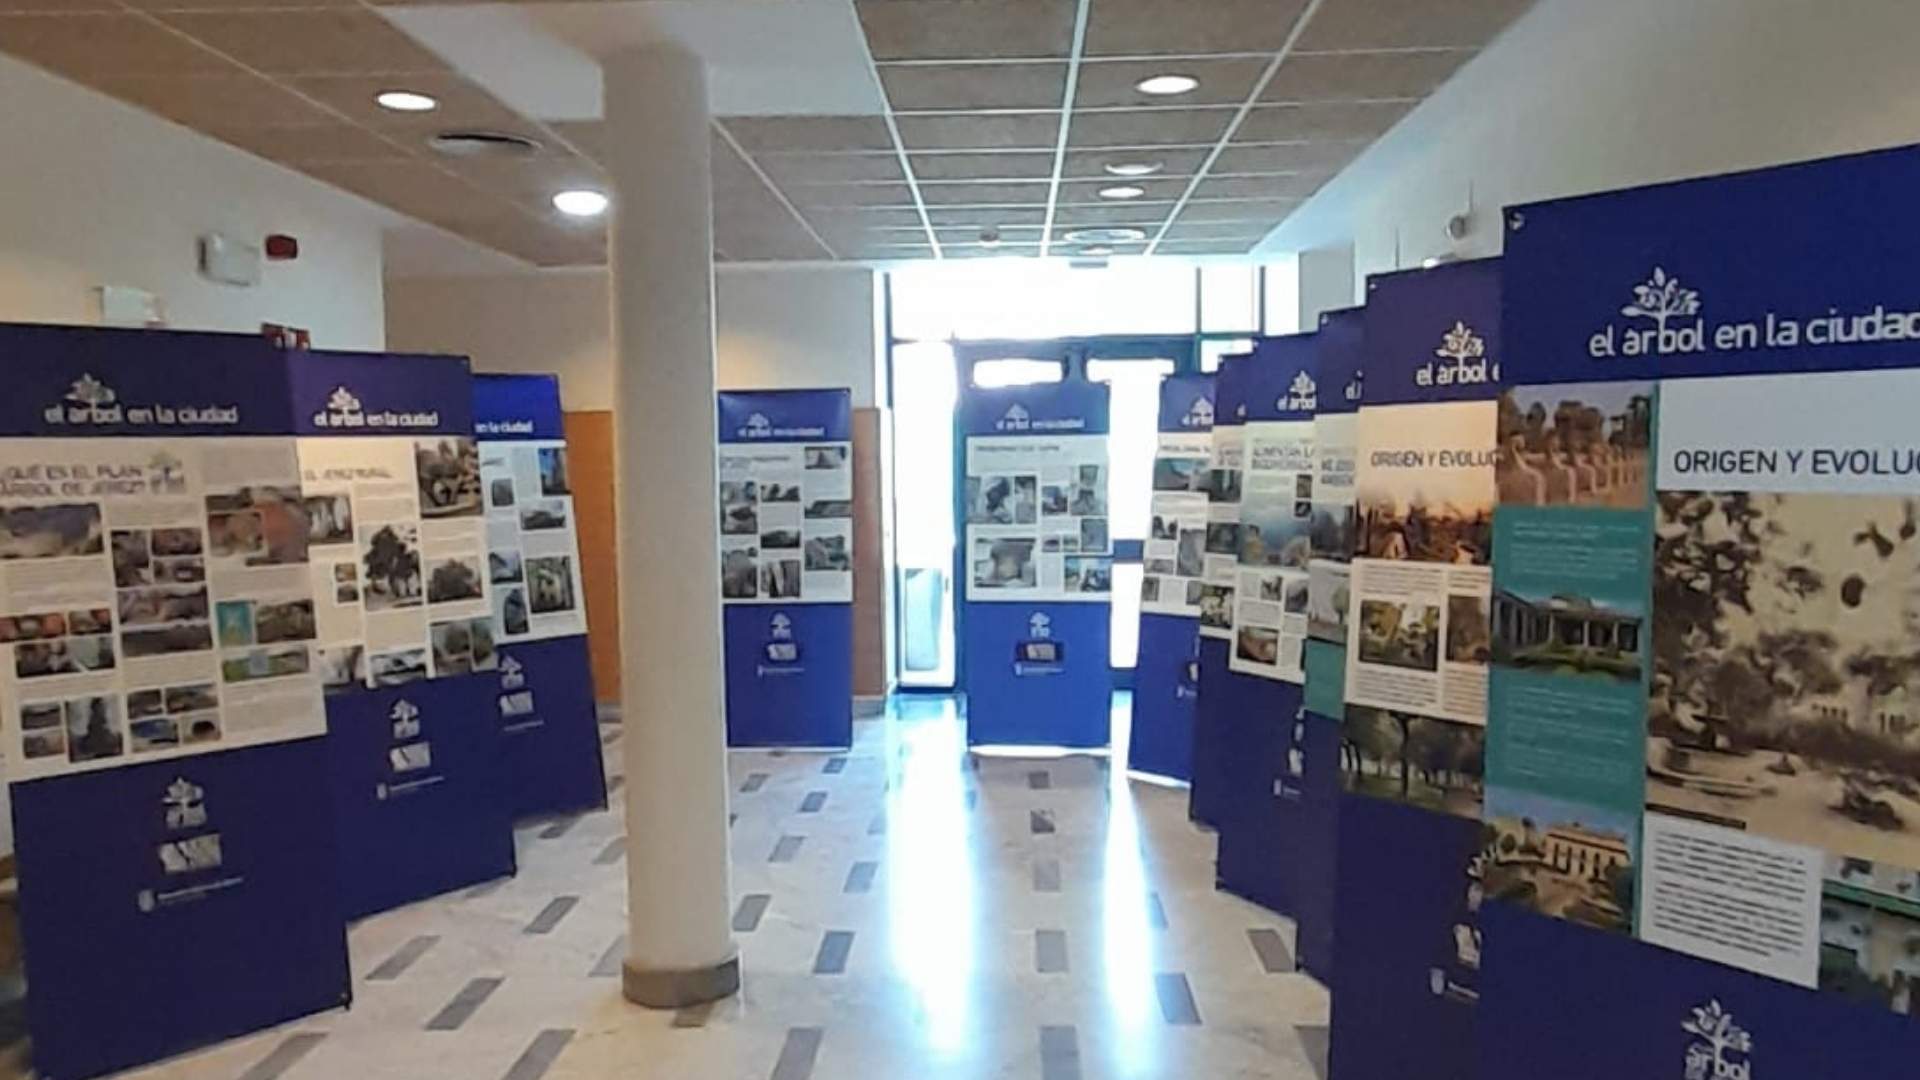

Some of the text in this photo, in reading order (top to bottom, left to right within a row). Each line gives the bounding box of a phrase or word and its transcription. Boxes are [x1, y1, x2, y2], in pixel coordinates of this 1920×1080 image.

[1588, 324, 1616, 357] el
[1715, 323, 1758, 350] en
[1766, 312, 1799, 347] la
[1416, 362, 1434, 386] el
[44, 403, 65, 424] el
[127, 408, 154, 424] en
[155, 404, 176, 424] la
[178, 405, 239, 425] ciudad
[314, 411, 329, 428] el
[400, 411, 439, 427] ciudad
[1370, 450, 1424, 468] ORIGEN
[1427, 450, 1438, 467] Y
[1673, 448, 1920, 475] ORIGEN Y EVOLU
